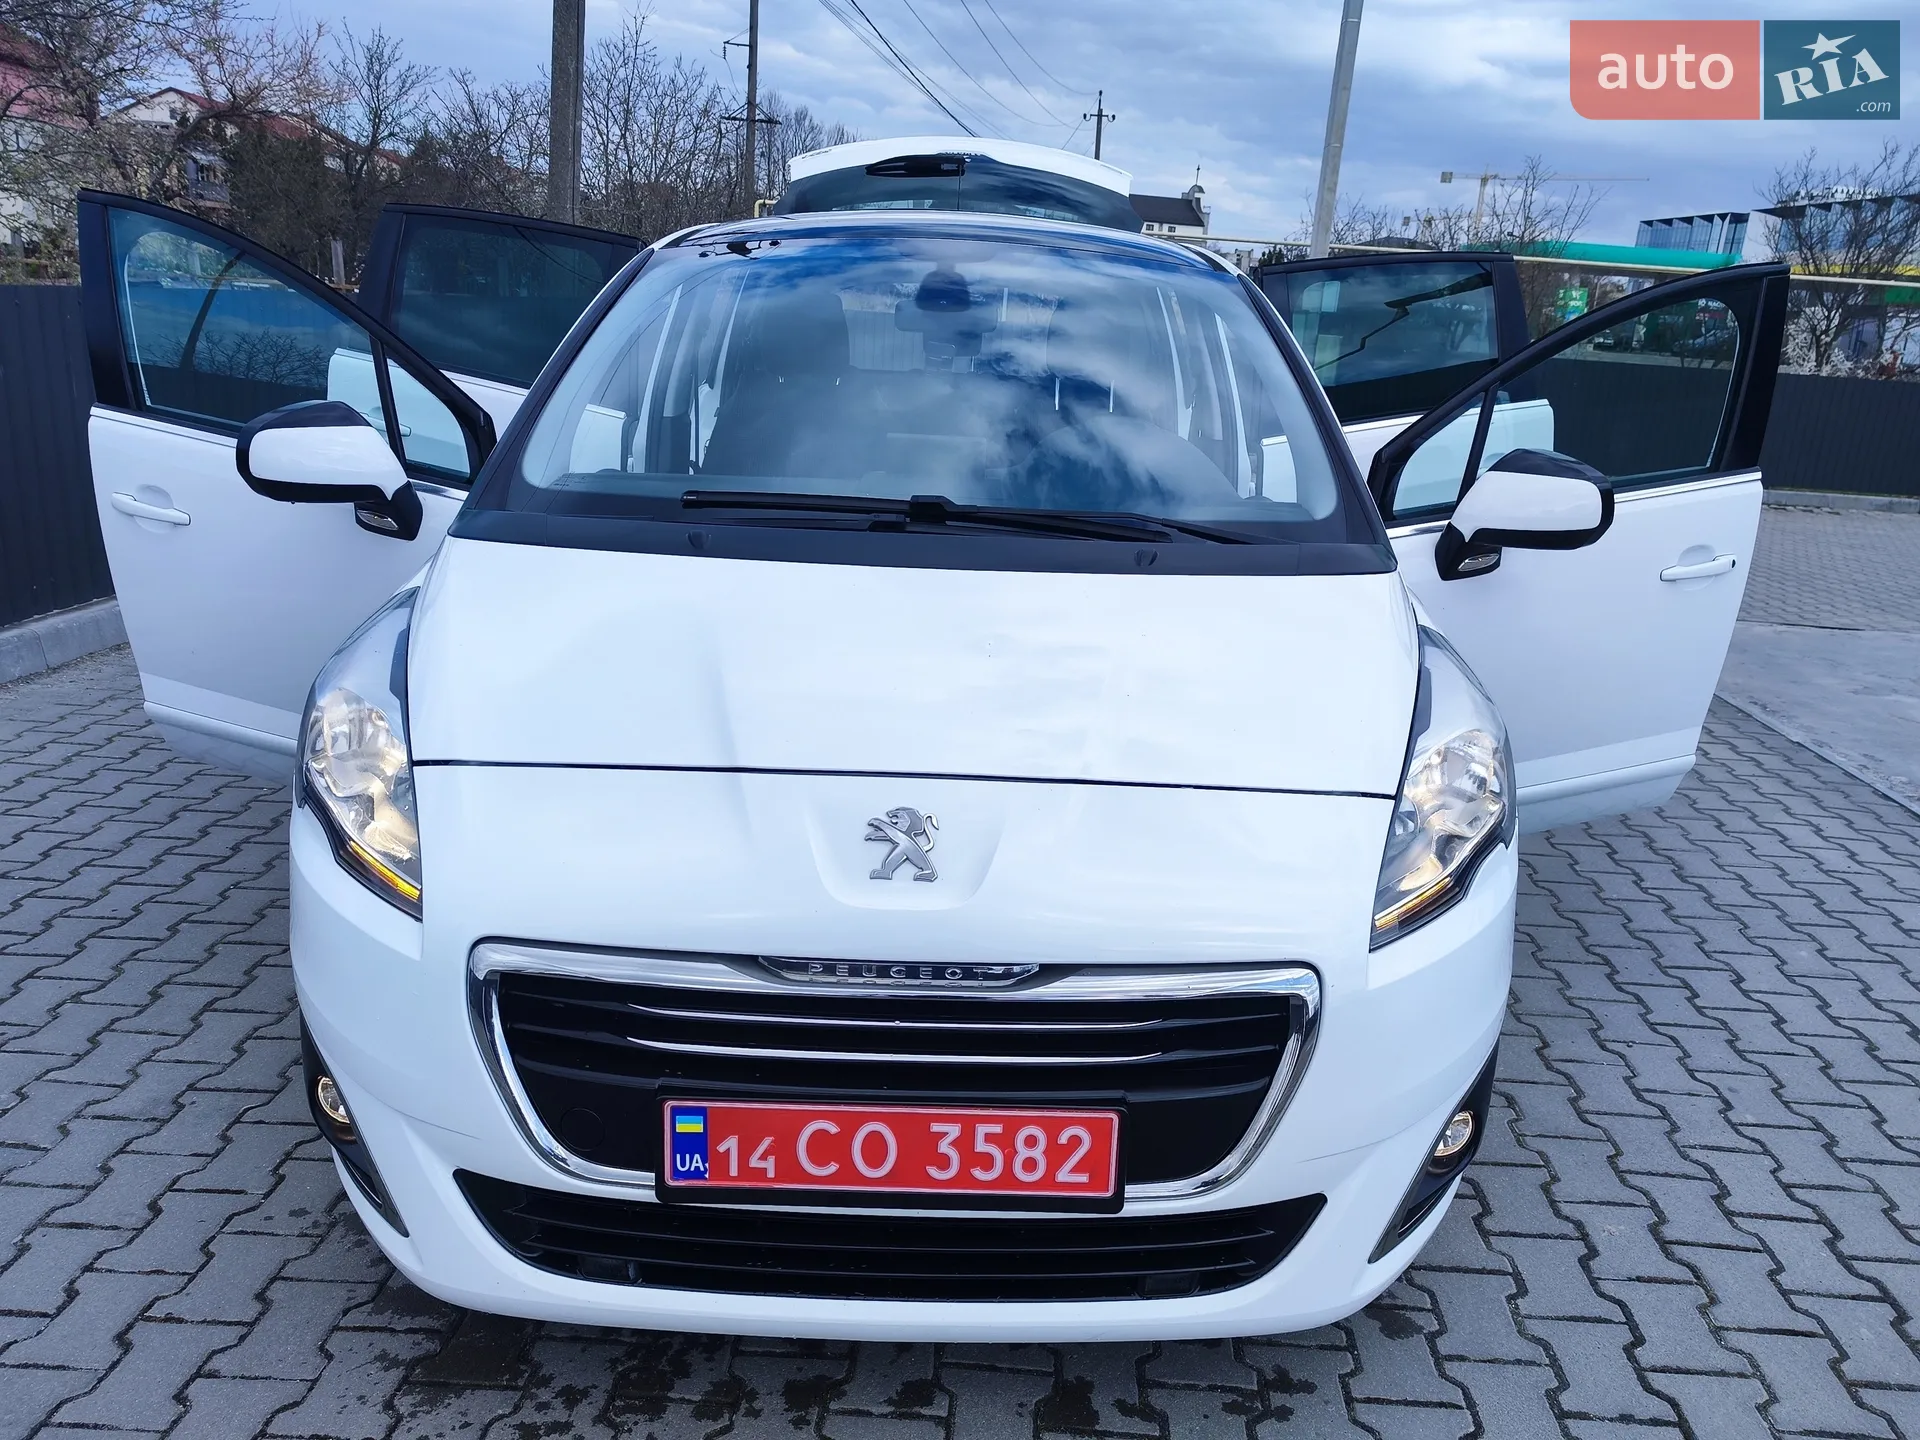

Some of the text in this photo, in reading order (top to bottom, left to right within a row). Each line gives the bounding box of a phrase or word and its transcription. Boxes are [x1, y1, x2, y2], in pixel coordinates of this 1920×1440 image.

[807, 962, 989, 981] PEUGEOT
[716, 1119, 1092, 1184] 14 CO 3582
[676, 1153, 705, 1172] UA
